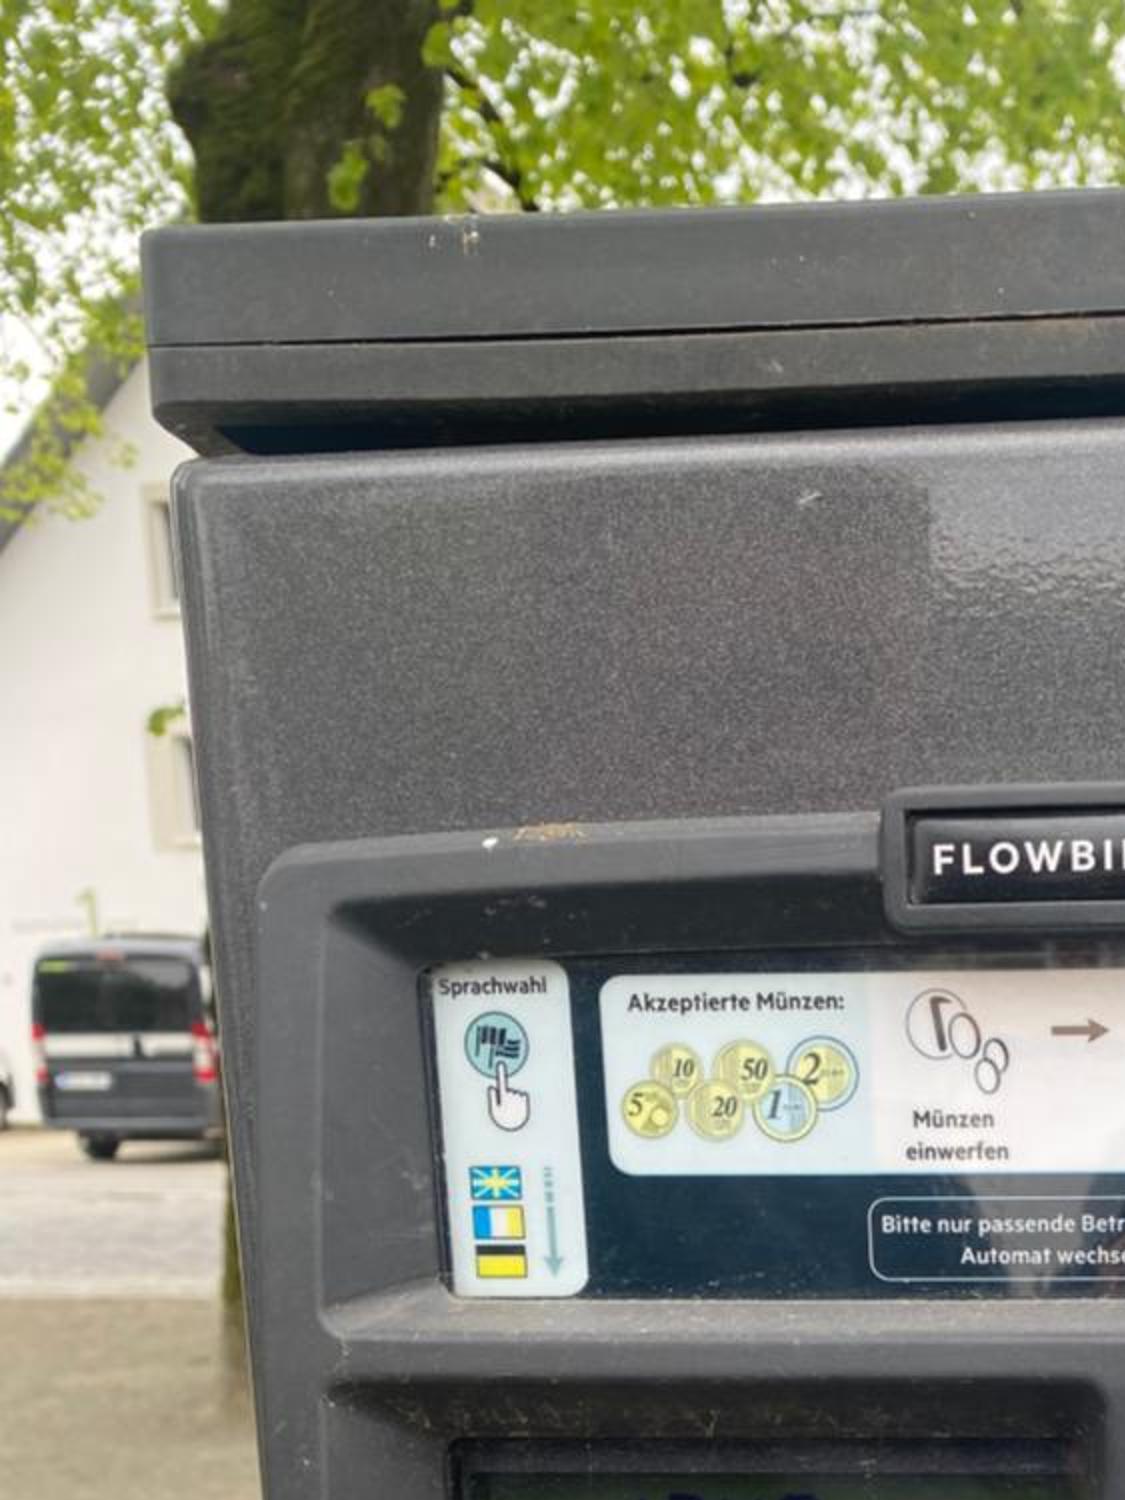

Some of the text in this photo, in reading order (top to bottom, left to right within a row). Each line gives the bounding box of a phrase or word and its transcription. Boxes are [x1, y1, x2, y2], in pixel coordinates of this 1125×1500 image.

[438, 977, 548, 997] Sprachwahl
[627, 992, 845, 1016] Akzeptierte Münzen:
[673, 1058, 695, 1078] 10
[741, 1058, 769, 1081] 50
[802, 1052, 823, 1087] 2
[628, 1093, 644, 1118] 5
[712, 1096, 738, 1118] 20
[767, 1090, 783, 1120] 1
[912, 1109, 995, 1128] Münzen
[906, 1142, 1009, 1161] einwerfen
[881, 1215, 932, 1233] Bitte
[937, 1221, 972, 1233] nur
[978, 1215, 1076, 1238] passende
[960, 1247, 1051, 1265] Automat
